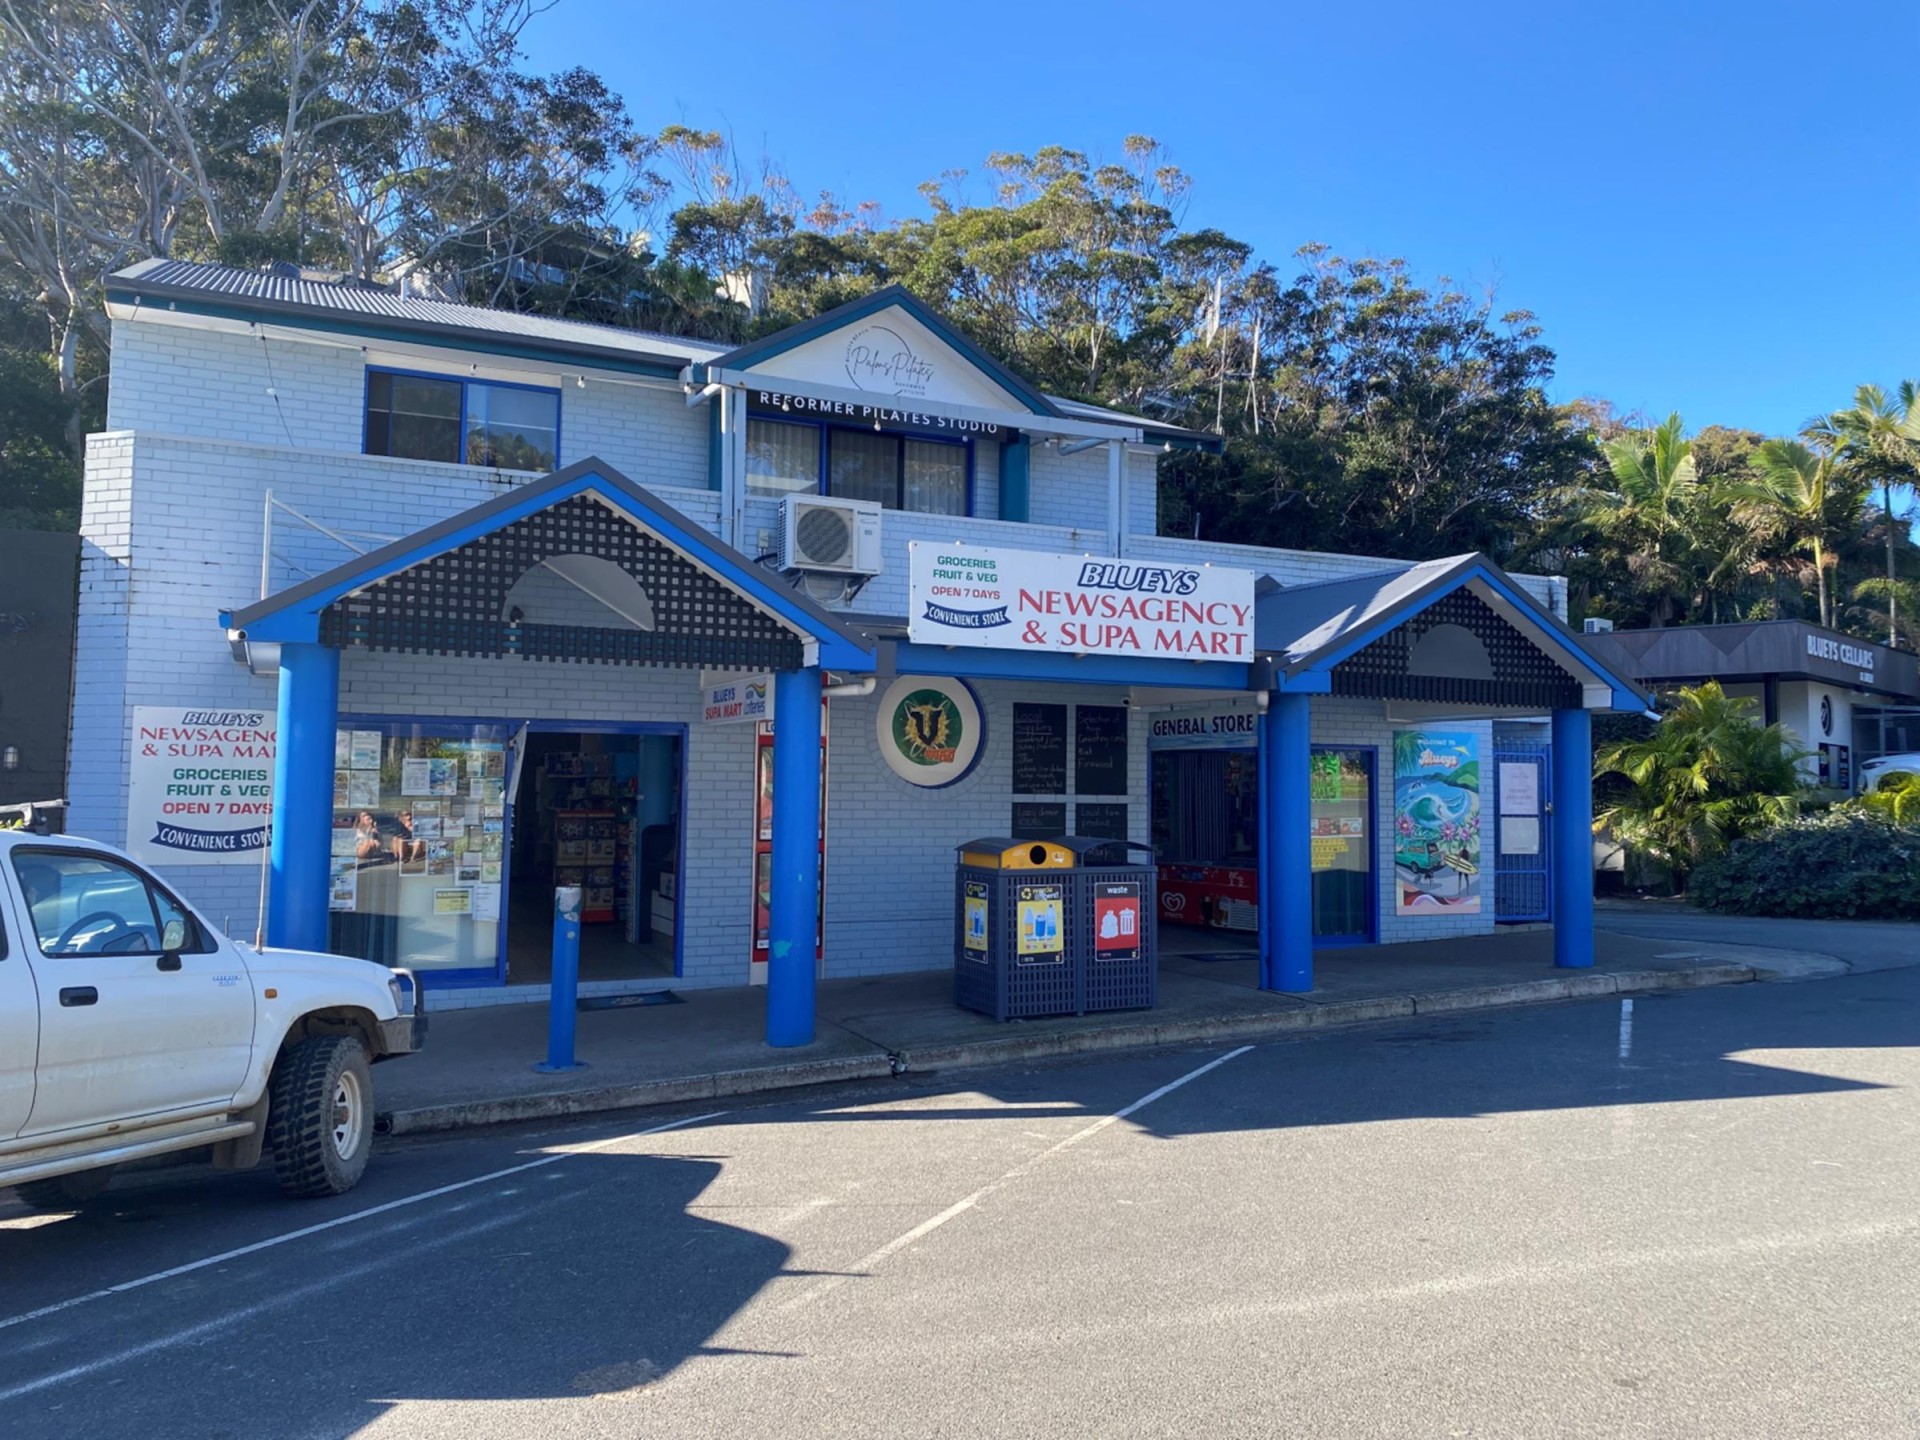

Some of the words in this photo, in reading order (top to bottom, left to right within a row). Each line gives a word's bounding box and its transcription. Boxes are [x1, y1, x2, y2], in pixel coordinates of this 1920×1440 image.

[760, 391, 855, 416] REFORMER
[863, 406, 930, 425] PILATES
[938, 417, 997, 433] STUDIO
[937, 556, 996, 569] GROCERIES
[933, 569, 962, 580] FRUIT
[966, 572, 973, 581] &
[977, 573, 998, 583] VEG
[1077, 562, 1201, 595] BLUEYS
[931, 586, 961, 597] OPEN
[963, 588, 970, 597] 7
[972, 589, 1000, 600] DAYS
[1019, 588, 1250, 626] NEWSAGENCY
[929, 606, 979, 626] CONVENIENCE
[982, 611, 1005, 625] STORE
[1022, 620, 1047, 645] &
[1060, 622, 1141, 649] SUPA
[1154, 628, 1248, 655] MART
[1807, 634, 1838, 661] BLUEYS
[1840, 644, 1873, 670] CELLARS
[713, 687, 736, 704] BLUEYS
[181, 711, 264, 727] BLUEYS
[705, 705, 721, 720] SUPA
[723, 702, 743, 718] MART
[1153, 717, 1207, 736] GENERAL
[1212, 713, 1253, 734] STORE
[140, 727, 277, 743] NEWSAGEN
[142, 743, 159, 756] &
[167, 743, 224, 757] SUPA
[233, 745, 276, 758] MA
[173, 768, 267, 781] GROCERIES
[166, 784, 215, 796] FRUIT
[220, 785, 232, 796] &
[238, 785, 271, 797] VEG
[162, 802, 210, 814] OPEN
[215, 803, 225, 814] 7
[229, 803, 273, 814] DAYS
[160, 828, 236, 849] CONVENIENCE
[1106, 886, 1129, 894] waste
